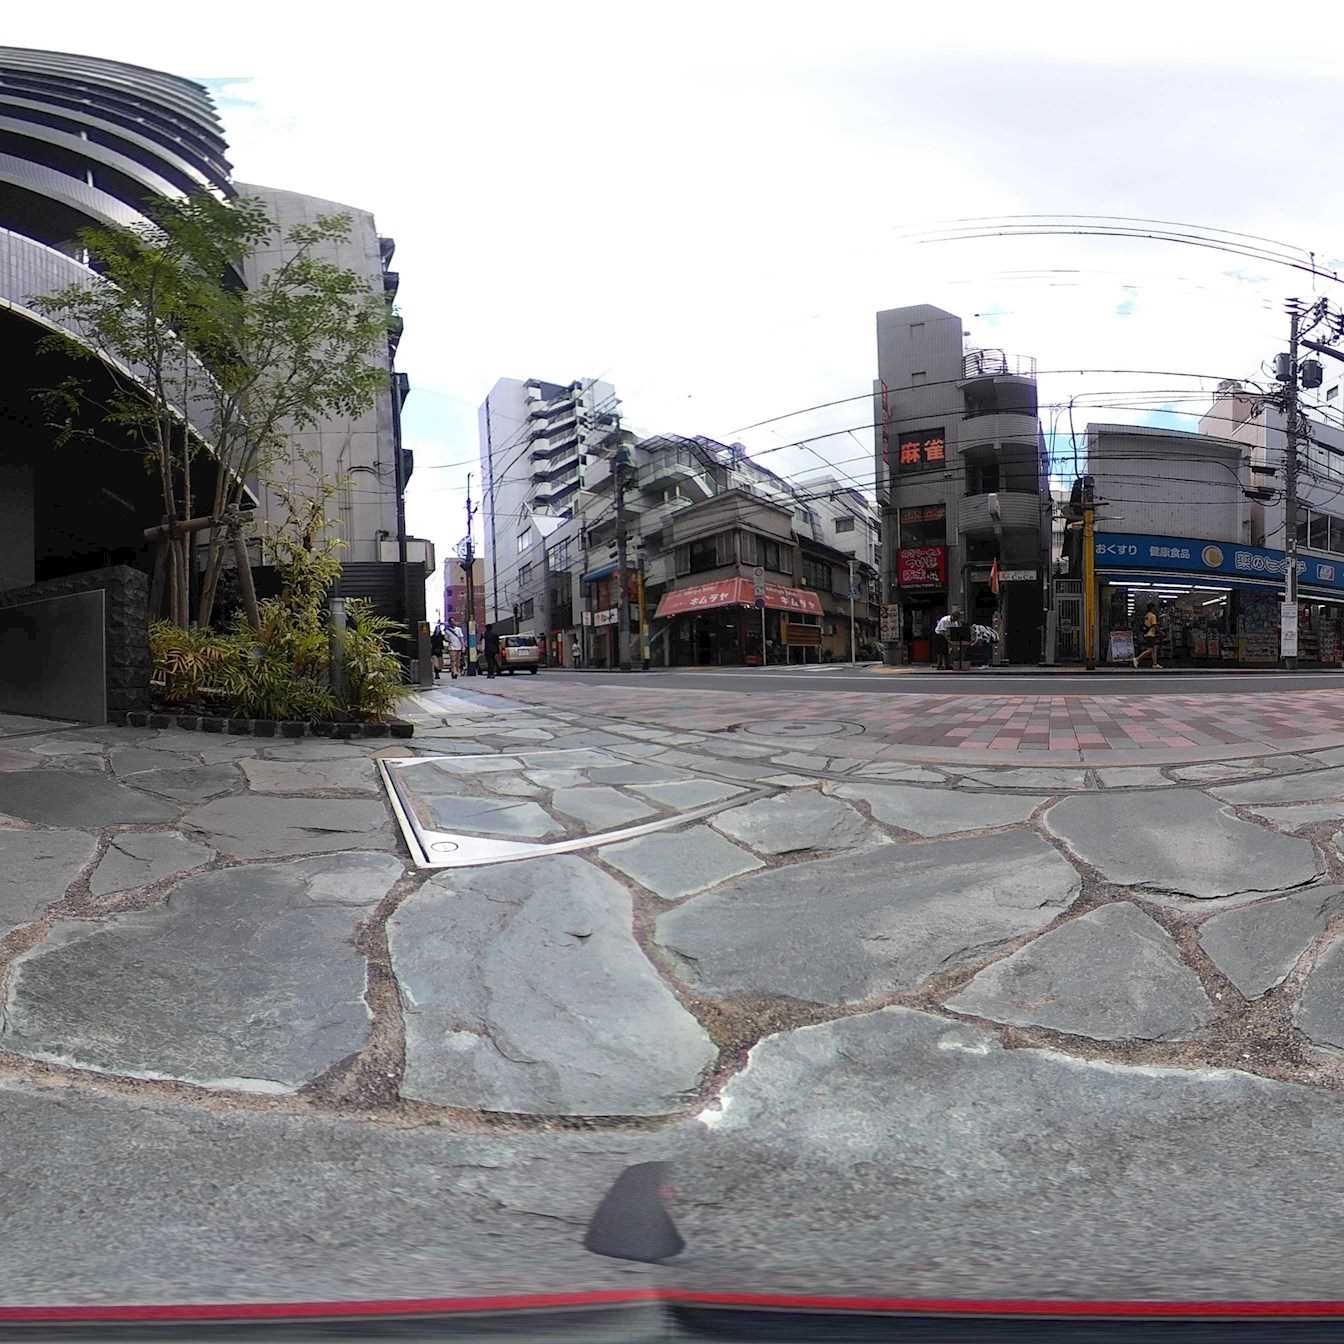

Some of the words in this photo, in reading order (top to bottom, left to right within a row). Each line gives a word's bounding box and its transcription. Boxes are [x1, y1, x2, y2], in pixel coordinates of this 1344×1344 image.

[900, 439, 945, 464] 麻雀
[1095, 543, 1137, 556] おくすり
